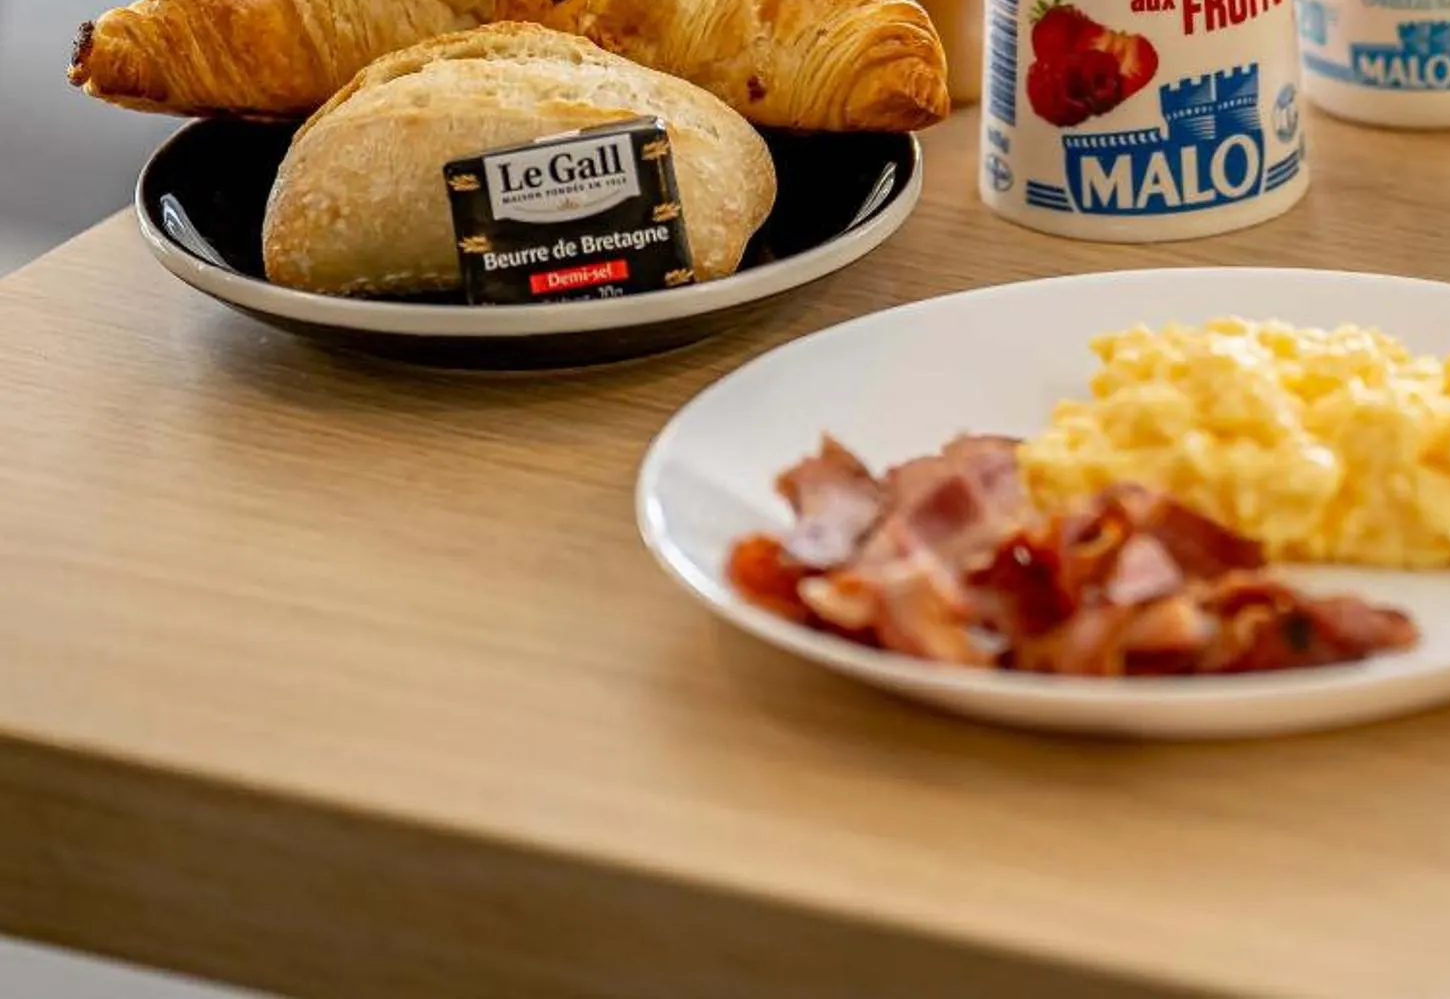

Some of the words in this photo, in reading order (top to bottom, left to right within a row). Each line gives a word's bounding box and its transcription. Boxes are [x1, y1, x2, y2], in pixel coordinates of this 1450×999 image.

[497, 162, 543, 194] Le
[548, 143, 626, 184] Gall
[1080, 133, 1260, 210] MALO
[502, 193, 543, 204] MAISON
[483, 243, 549, 271] Beurre
[552, 238, 578, 259] de
[581, 225, 670, 254] Bretagne
[547, 262, 613, 287] Demi-sel
